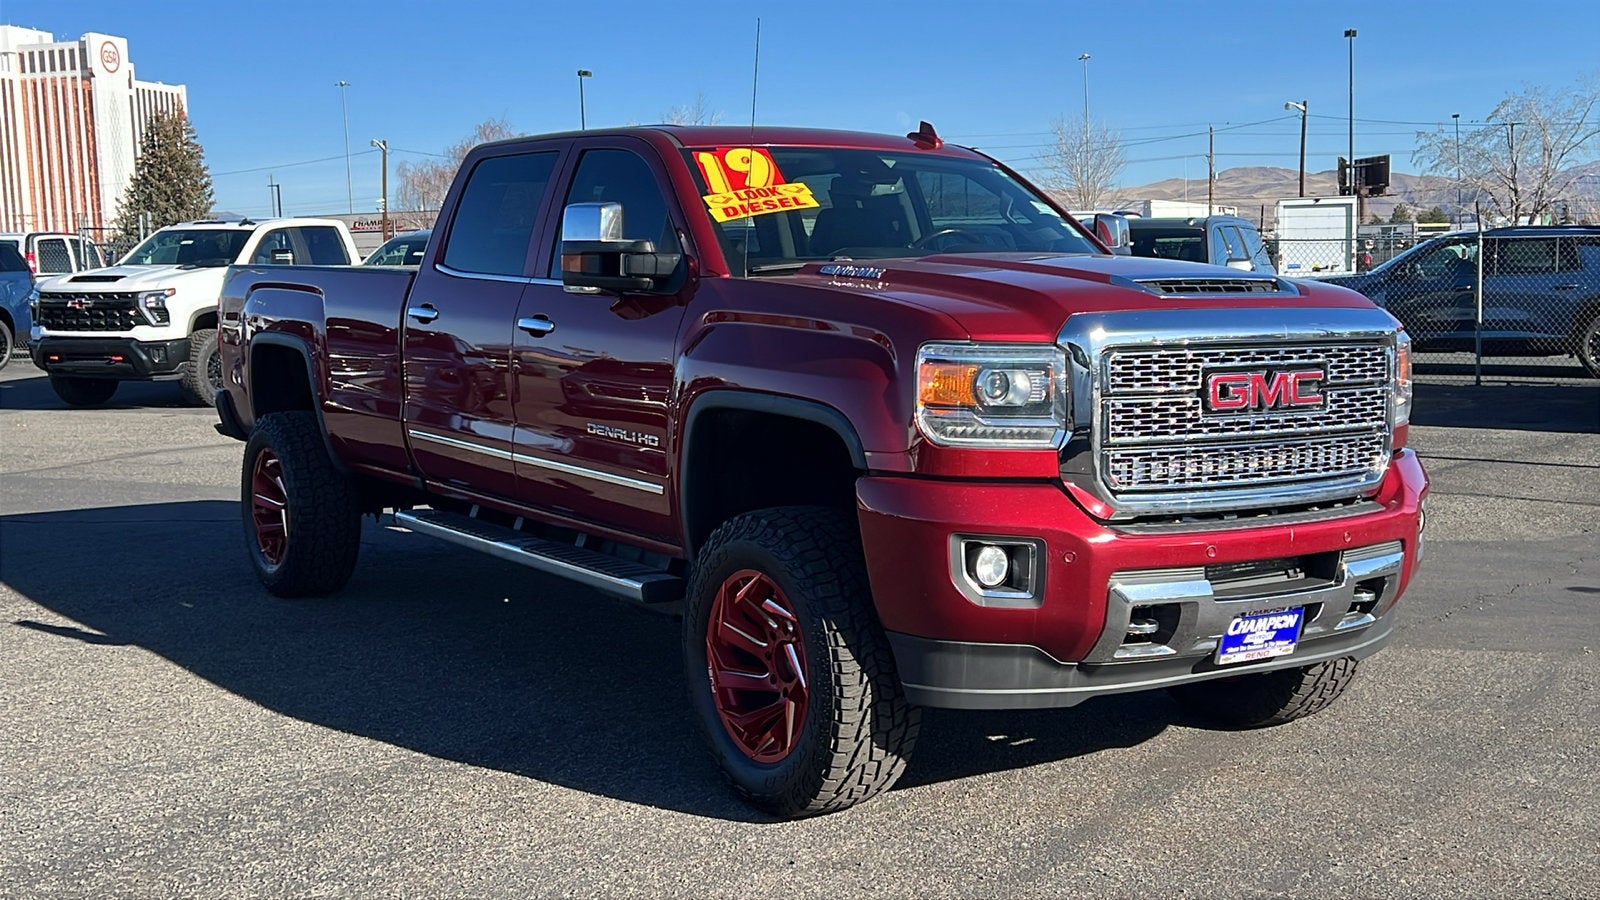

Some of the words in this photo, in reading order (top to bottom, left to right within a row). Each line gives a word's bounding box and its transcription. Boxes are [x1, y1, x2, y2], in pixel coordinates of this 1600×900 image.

[103, 49, 118, 65] GSR
[698, 148, 775, 194] 19
[734, 186, 783, 201] LOOK
[722, 196, 808, 218] DIESEL
[1209, 370, 1324, 410] GMC
[587, 422, 636, 443] DENALI
[638, 432, 659, 447] HD
[1227, 614, 1299, 636] CHAMPION
[1245, 651, 1270, 660] RENO
